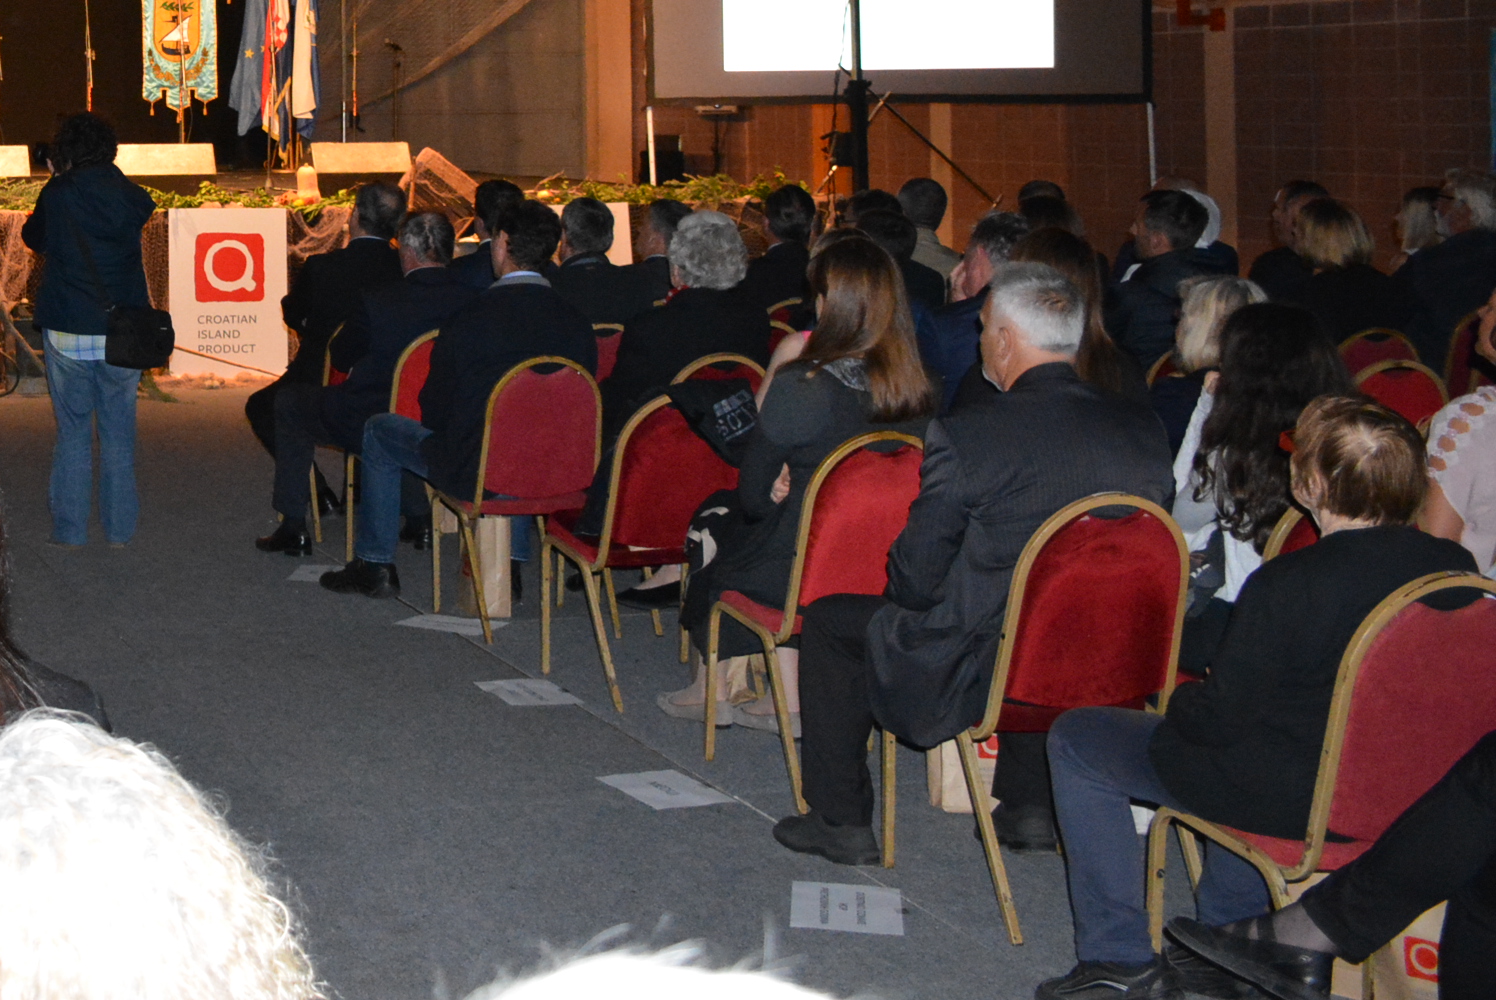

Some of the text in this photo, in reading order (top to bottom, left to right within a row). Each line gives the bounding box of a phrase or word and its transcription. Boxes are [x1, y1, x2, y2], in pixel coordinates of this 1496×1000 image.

[197, 315, 257, 325] CROATIAN
[197, 330, 241, 339] ISLAND
[197, 344, 256, 354] PRODUCT
